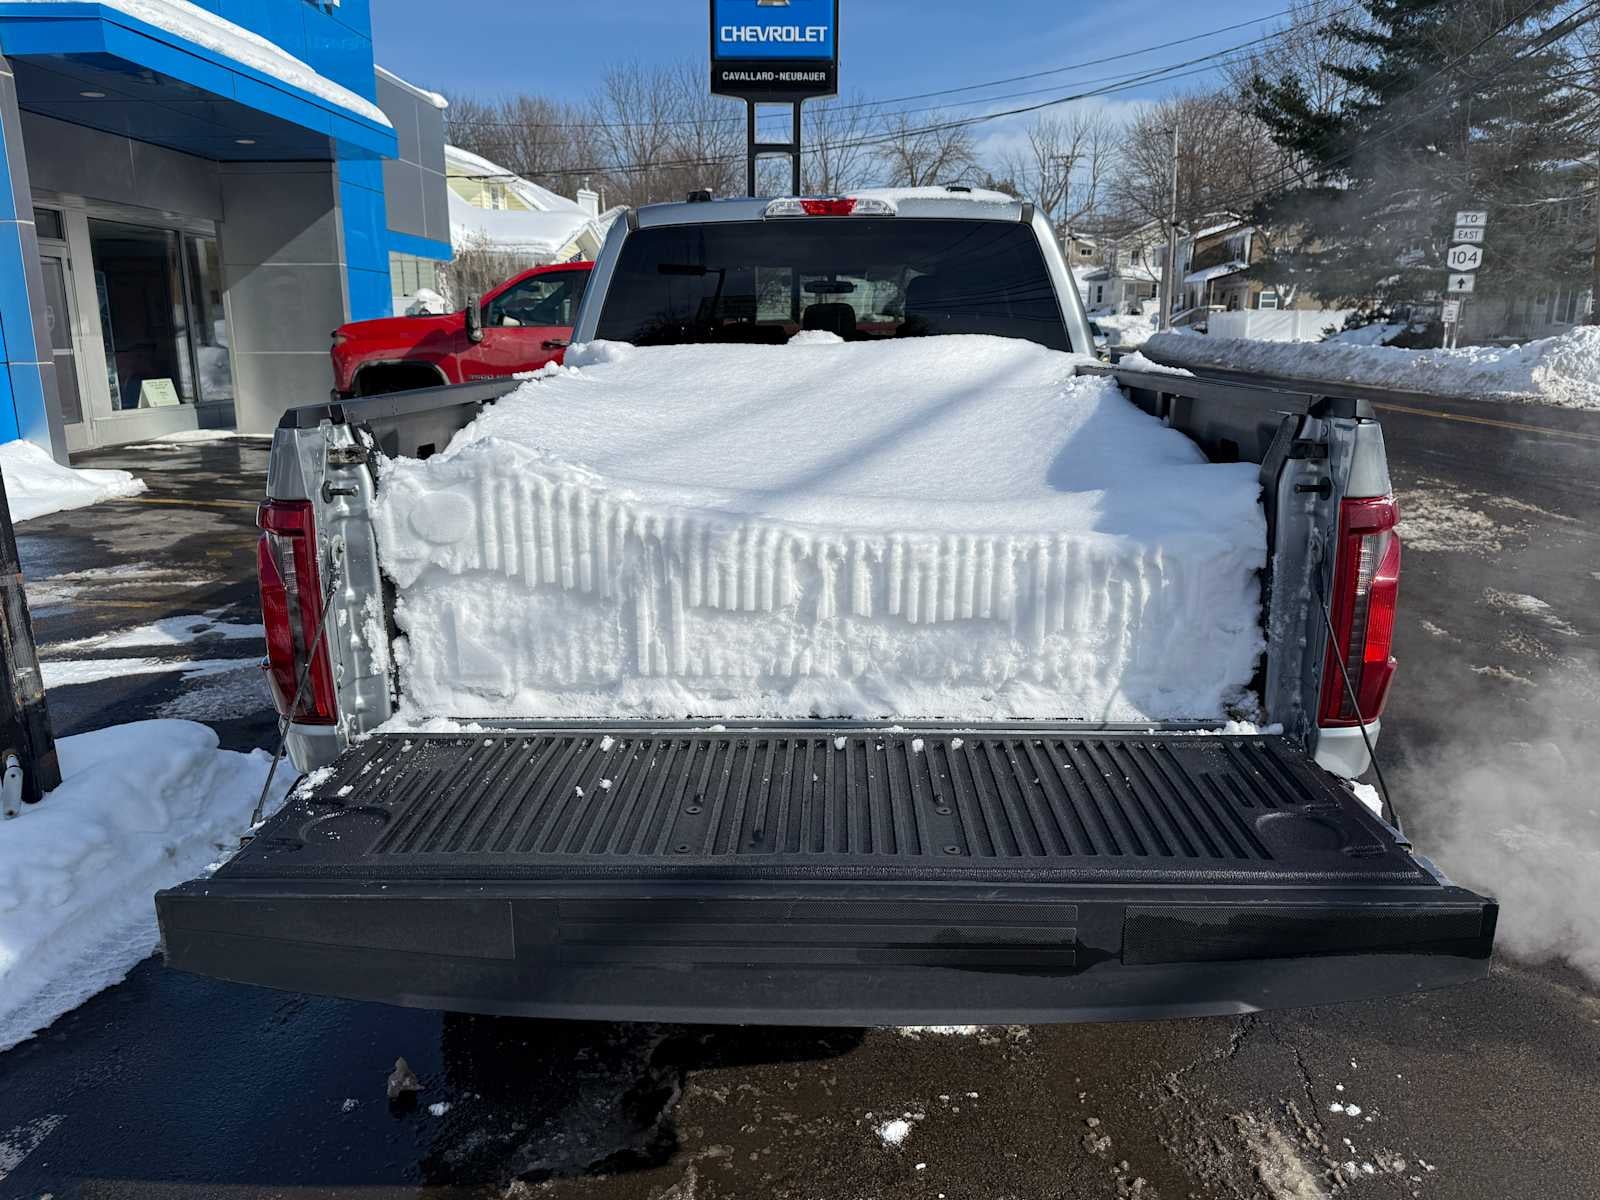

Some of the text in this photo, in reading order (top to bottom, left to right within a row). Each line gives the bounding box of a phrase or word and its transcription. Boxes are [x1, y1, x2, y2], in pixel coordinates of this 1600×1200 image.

[720, 25, 828, 42] CHEVROLET
[722, 71, 826, 81] CAVALLARO-NEUBAUER
[1463, 214, 1478, 223] TO
[1458, 230, 1479, 240] EAST
[1451, 251, 1478, 265] 104
